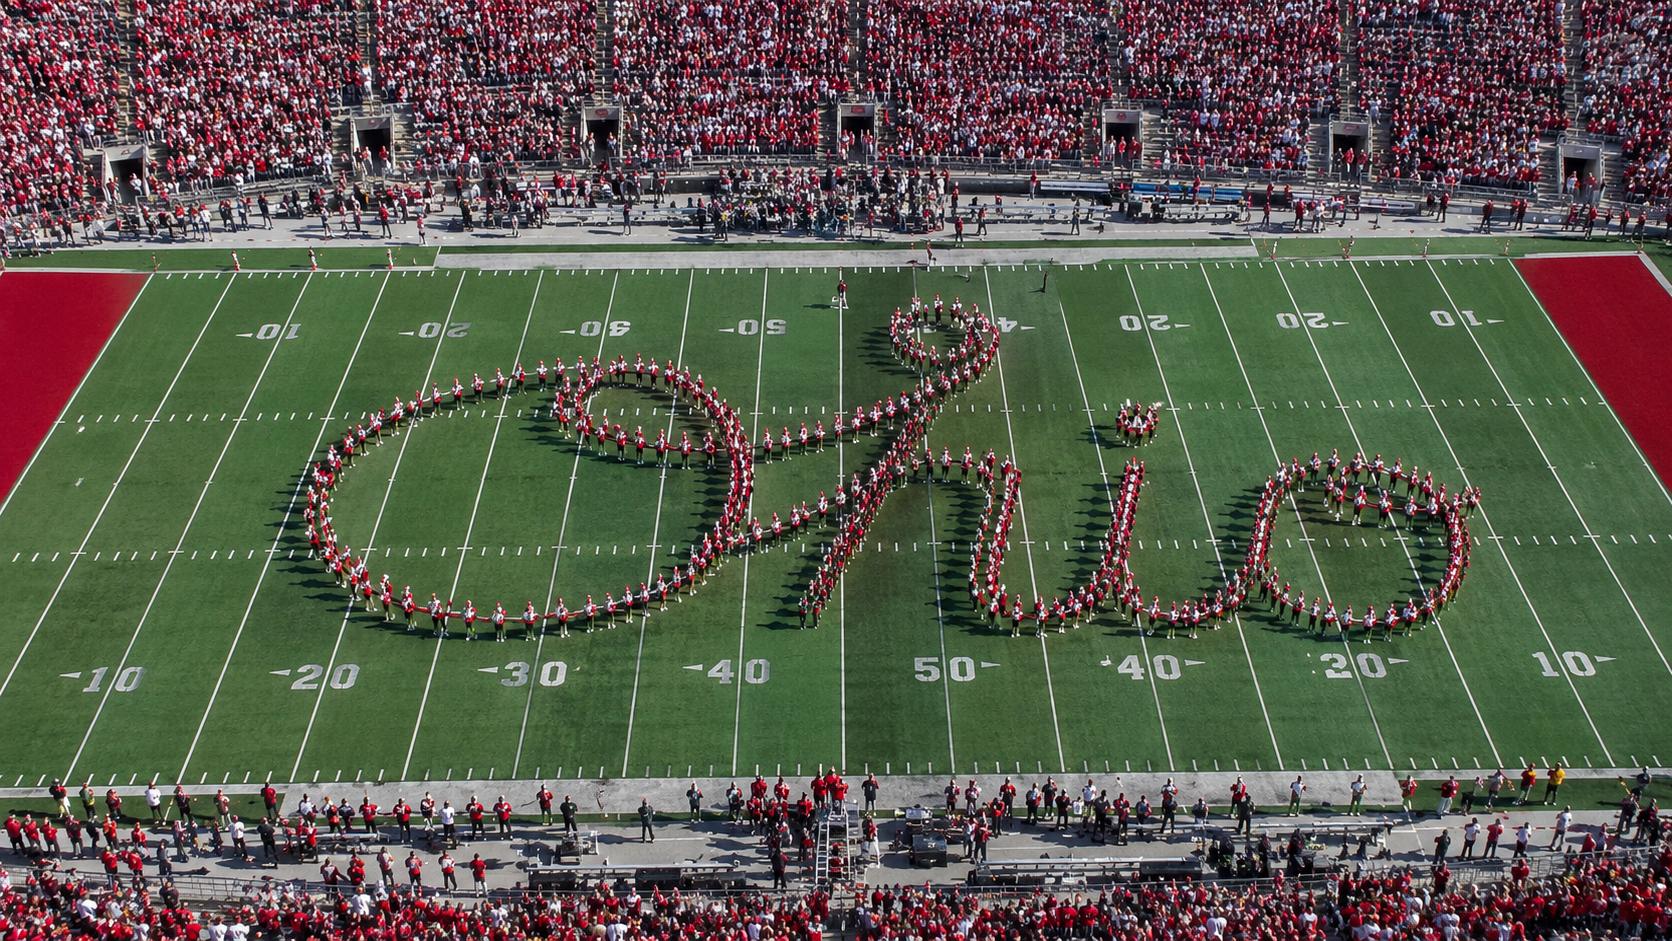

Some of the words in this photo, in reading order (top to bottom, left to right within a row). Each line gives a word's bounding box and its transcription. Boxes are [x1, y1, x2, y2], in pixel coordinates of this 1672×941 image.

[418, 322, 472, 338] 20
[738, 319, 787, 335] 50
[1119, 315, 1171, 331] 20
[1275, 313, 1329, 329] 20
[1429, 310, 1483, 326] 10
[256, 323, 302, 340] 10
[290, 664, 361, 690] 20
[501, 661, 568, 687] 30
[707, 658, 770, 684] 40
[914, 656, 976, 682] 50
[1117, 654, 1182, 680] 40
[1532, 651, 1597, 677] 10
[82, 666, 147, 692] 10
